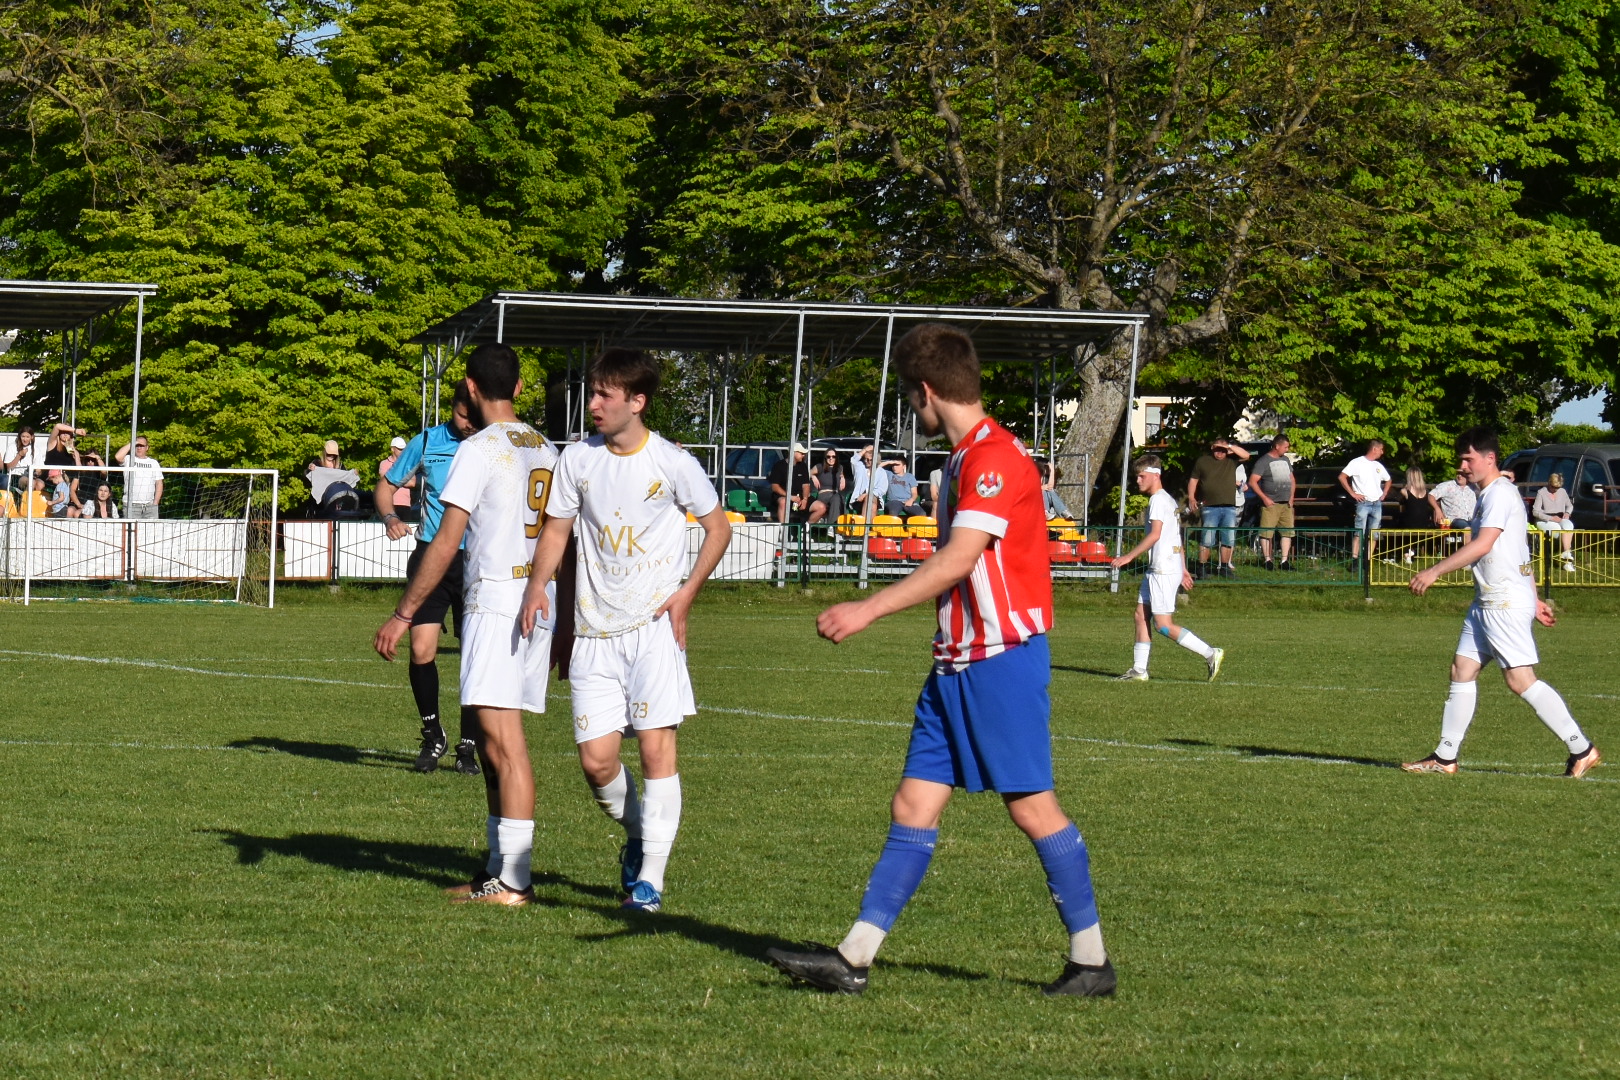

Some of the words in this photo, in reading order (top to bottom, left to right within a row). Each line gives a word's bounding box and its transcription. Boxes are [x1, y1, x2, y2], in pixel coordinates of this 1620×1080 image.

[525, 468, 553, 539] 9
[598, 525, 649, 557] WK
[578, 552, 674, 577] CNSULTING
[632, 702, 649, 719] 23
